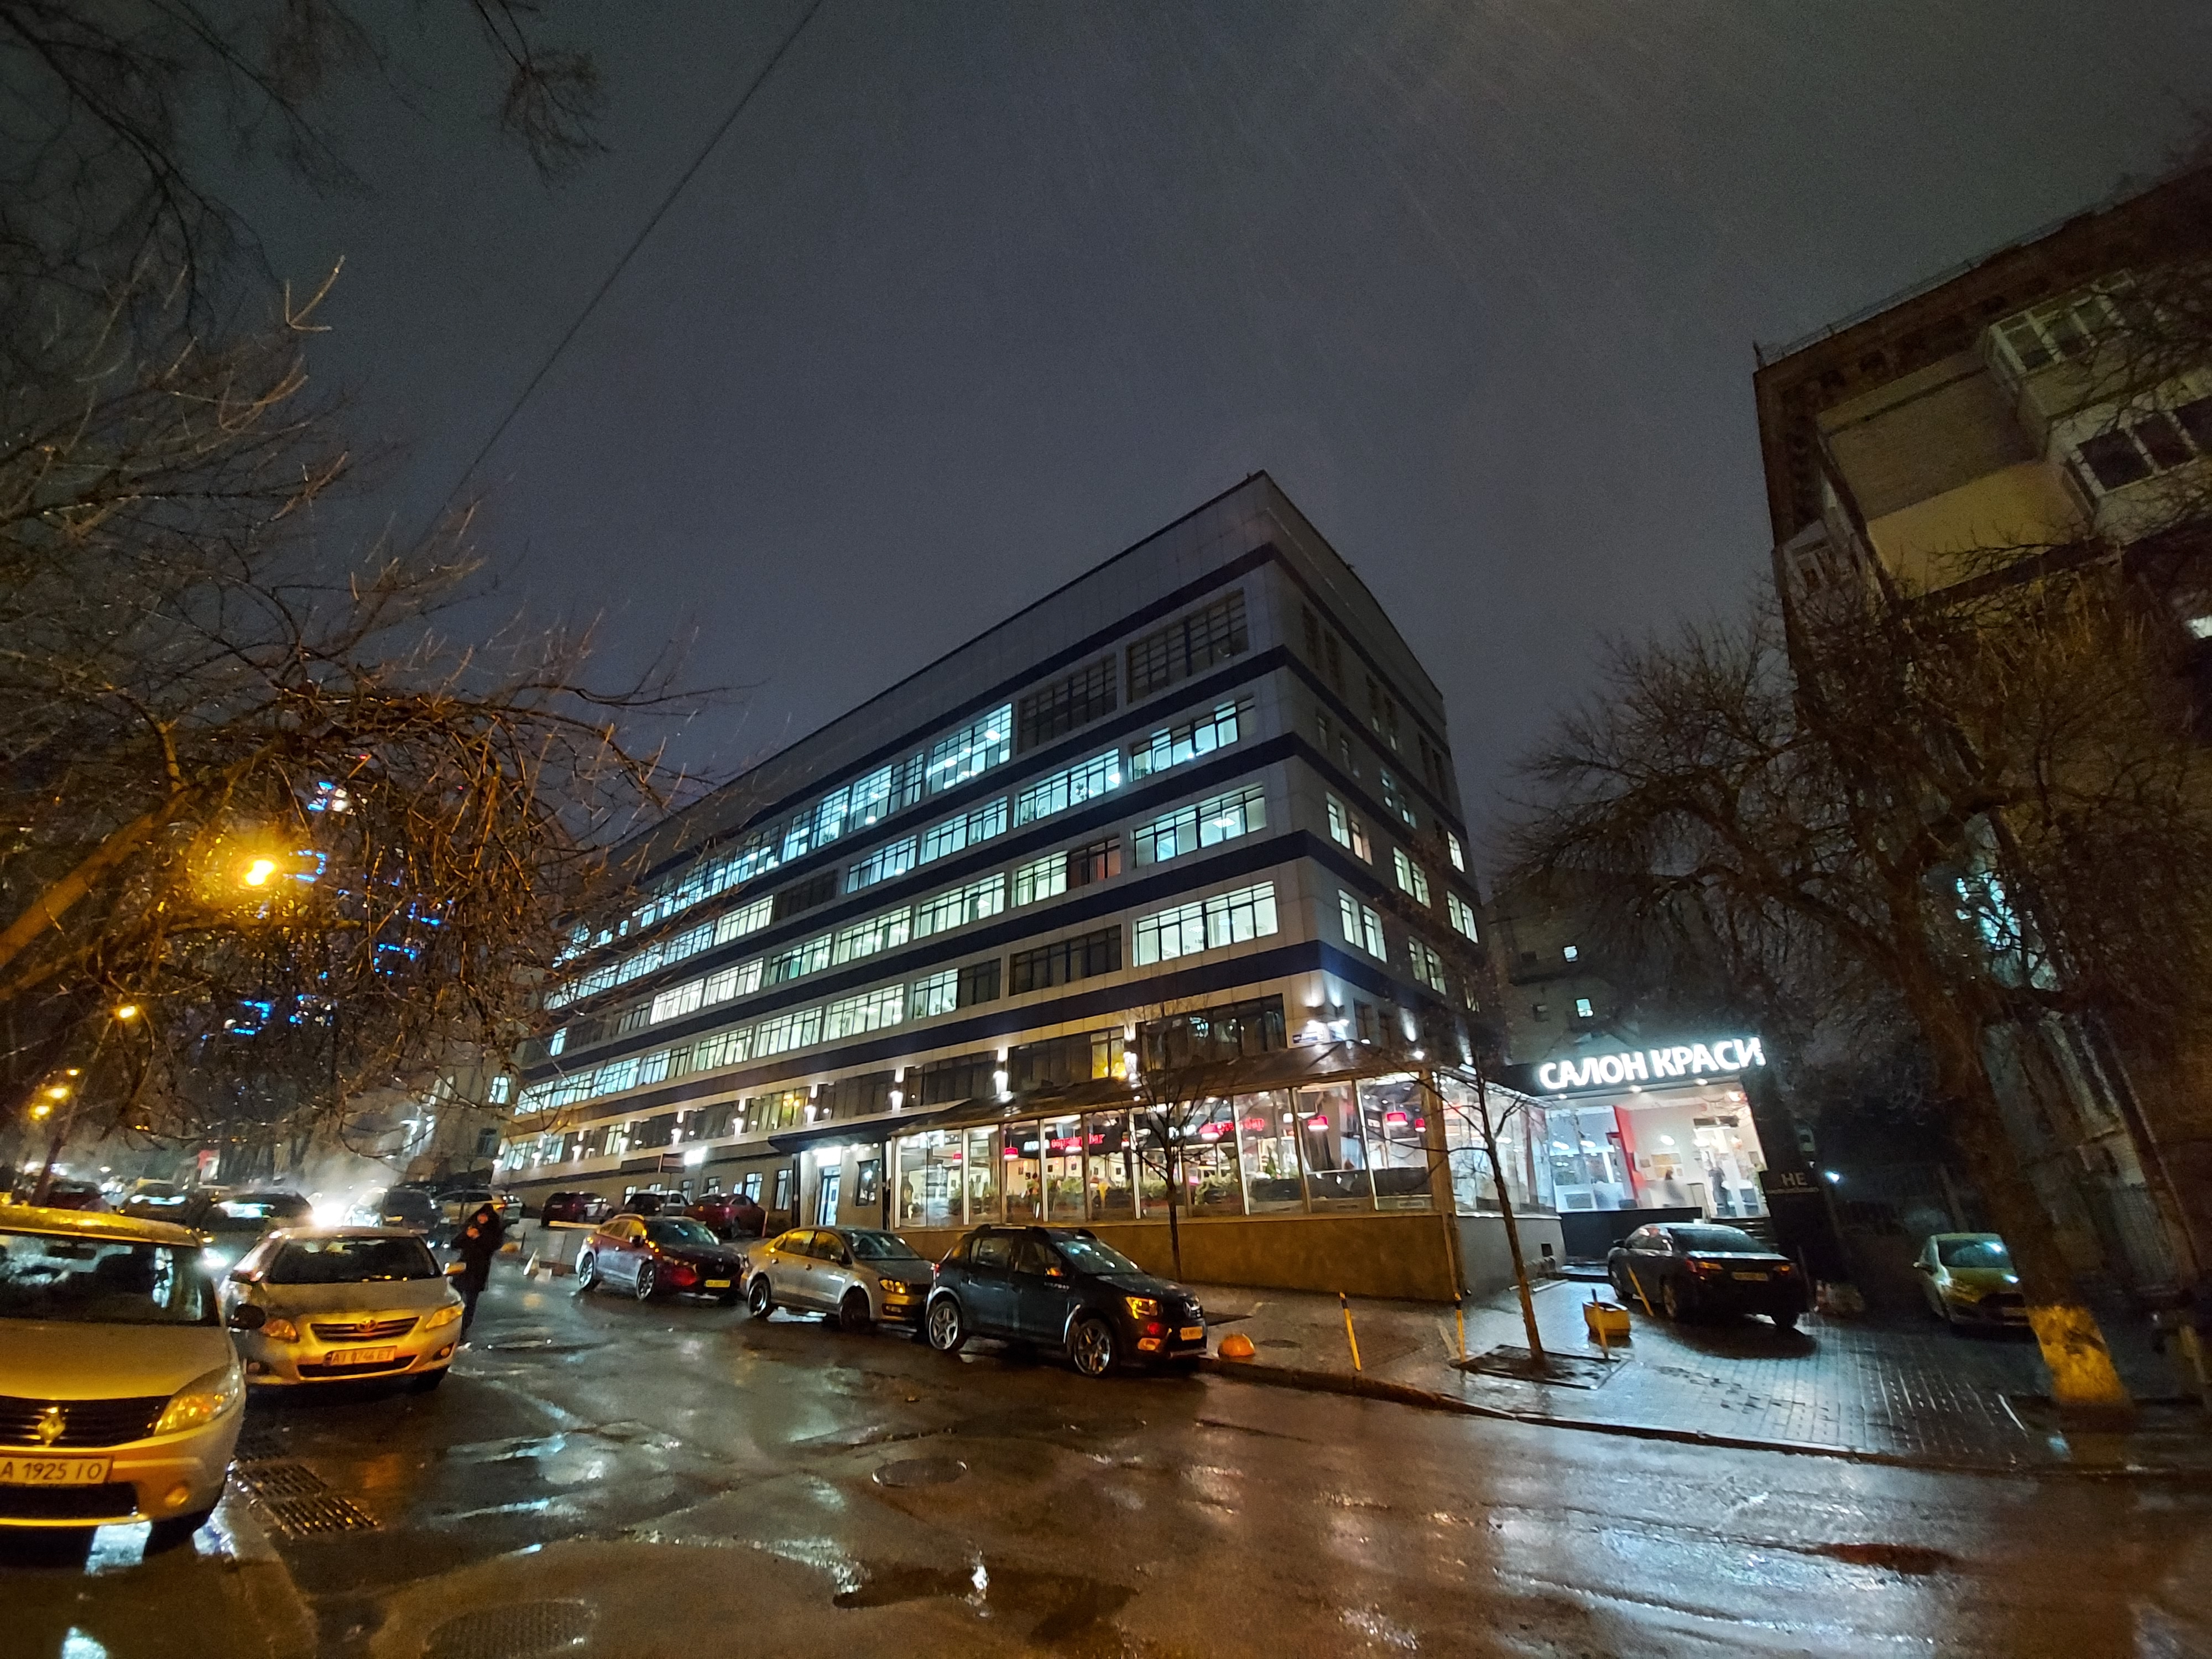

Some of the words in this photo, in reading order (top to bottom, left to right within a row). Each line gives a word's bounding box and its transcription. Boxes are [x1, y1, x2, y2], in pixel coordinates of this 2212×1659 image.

[1538, 1051, 1649, 1089] САЛОН
[1650, 1037, 1767, 1079] КРАСИ
[23, 1462, 67, 1480] 1925
